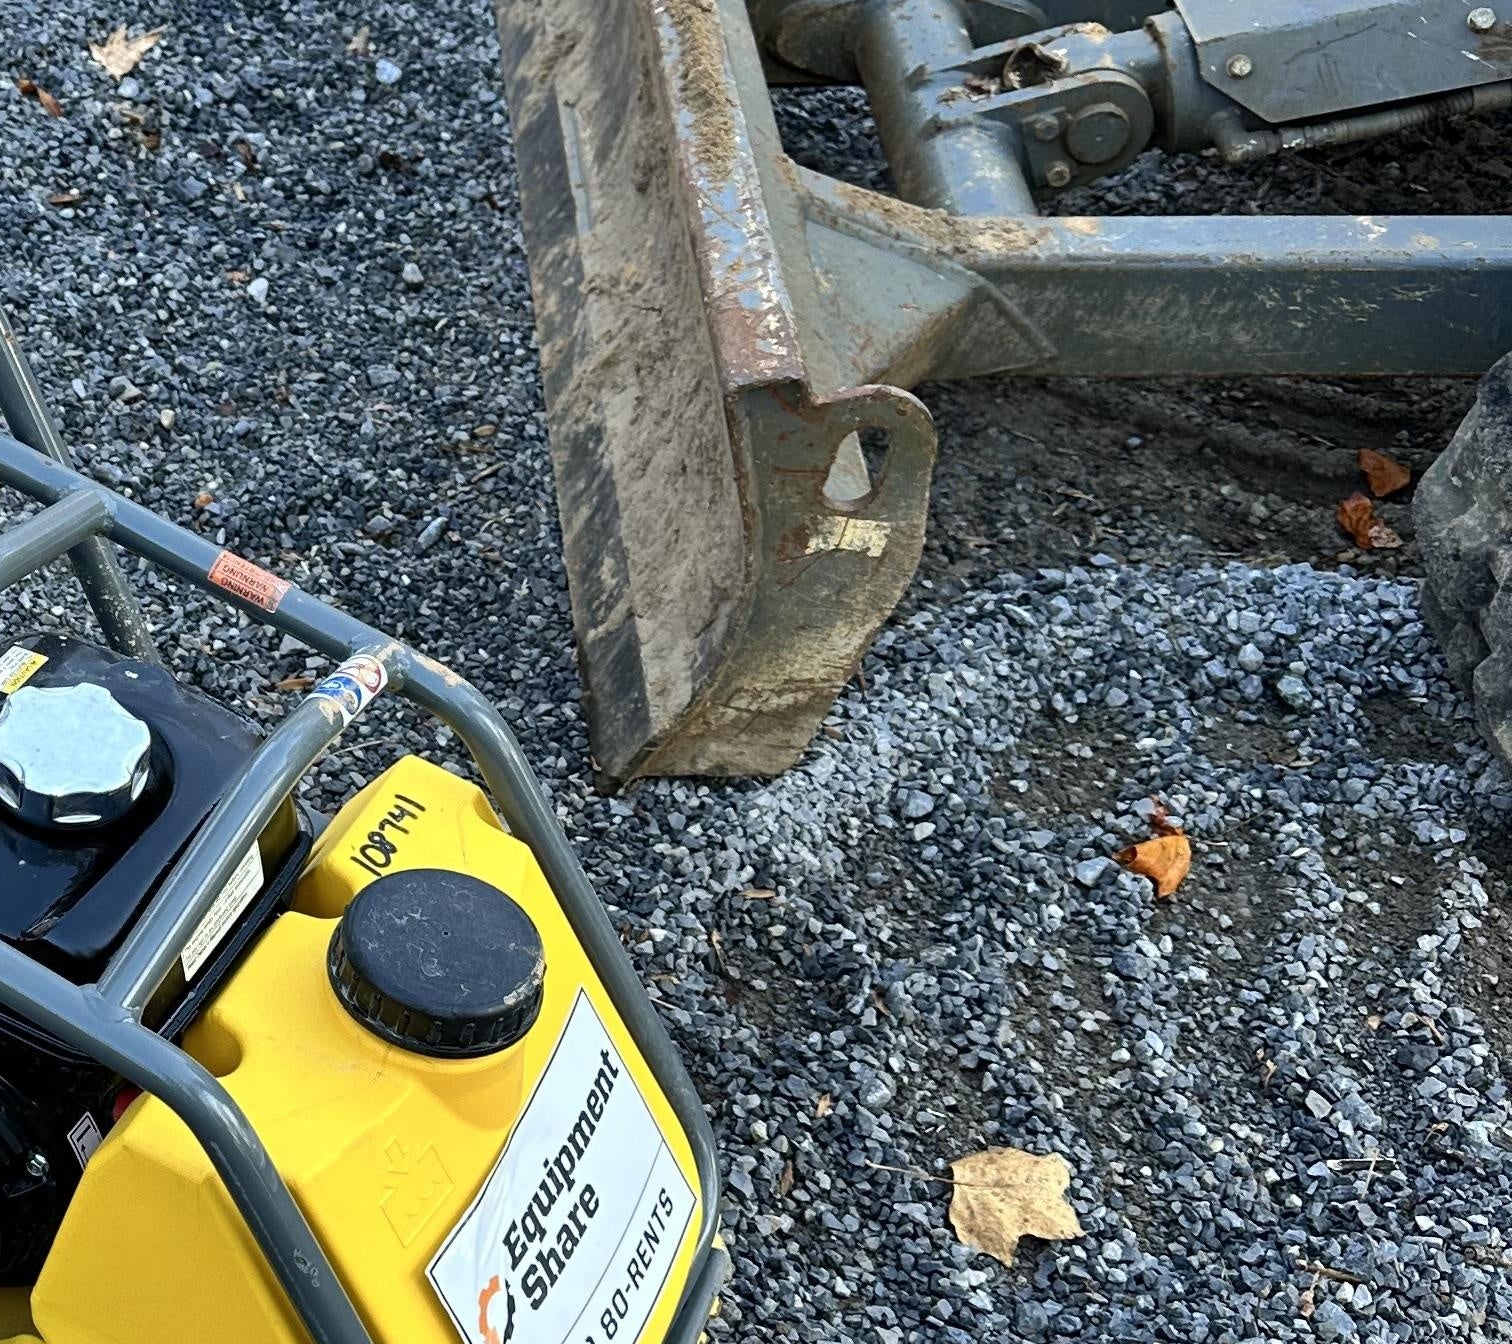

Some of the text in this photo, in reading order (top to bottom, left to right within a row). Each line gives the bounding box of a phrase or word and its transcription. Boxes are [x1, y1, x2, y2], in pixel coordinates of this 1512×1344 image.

[220, 578, 265, 605] WARNING
[350, 794, 426, 877] 108741
[502, 1048, 621, 1270] Equipment
[520, 1182, 601, 1311] Share
[600, 1187, 674, 1341] 80-RENTS
